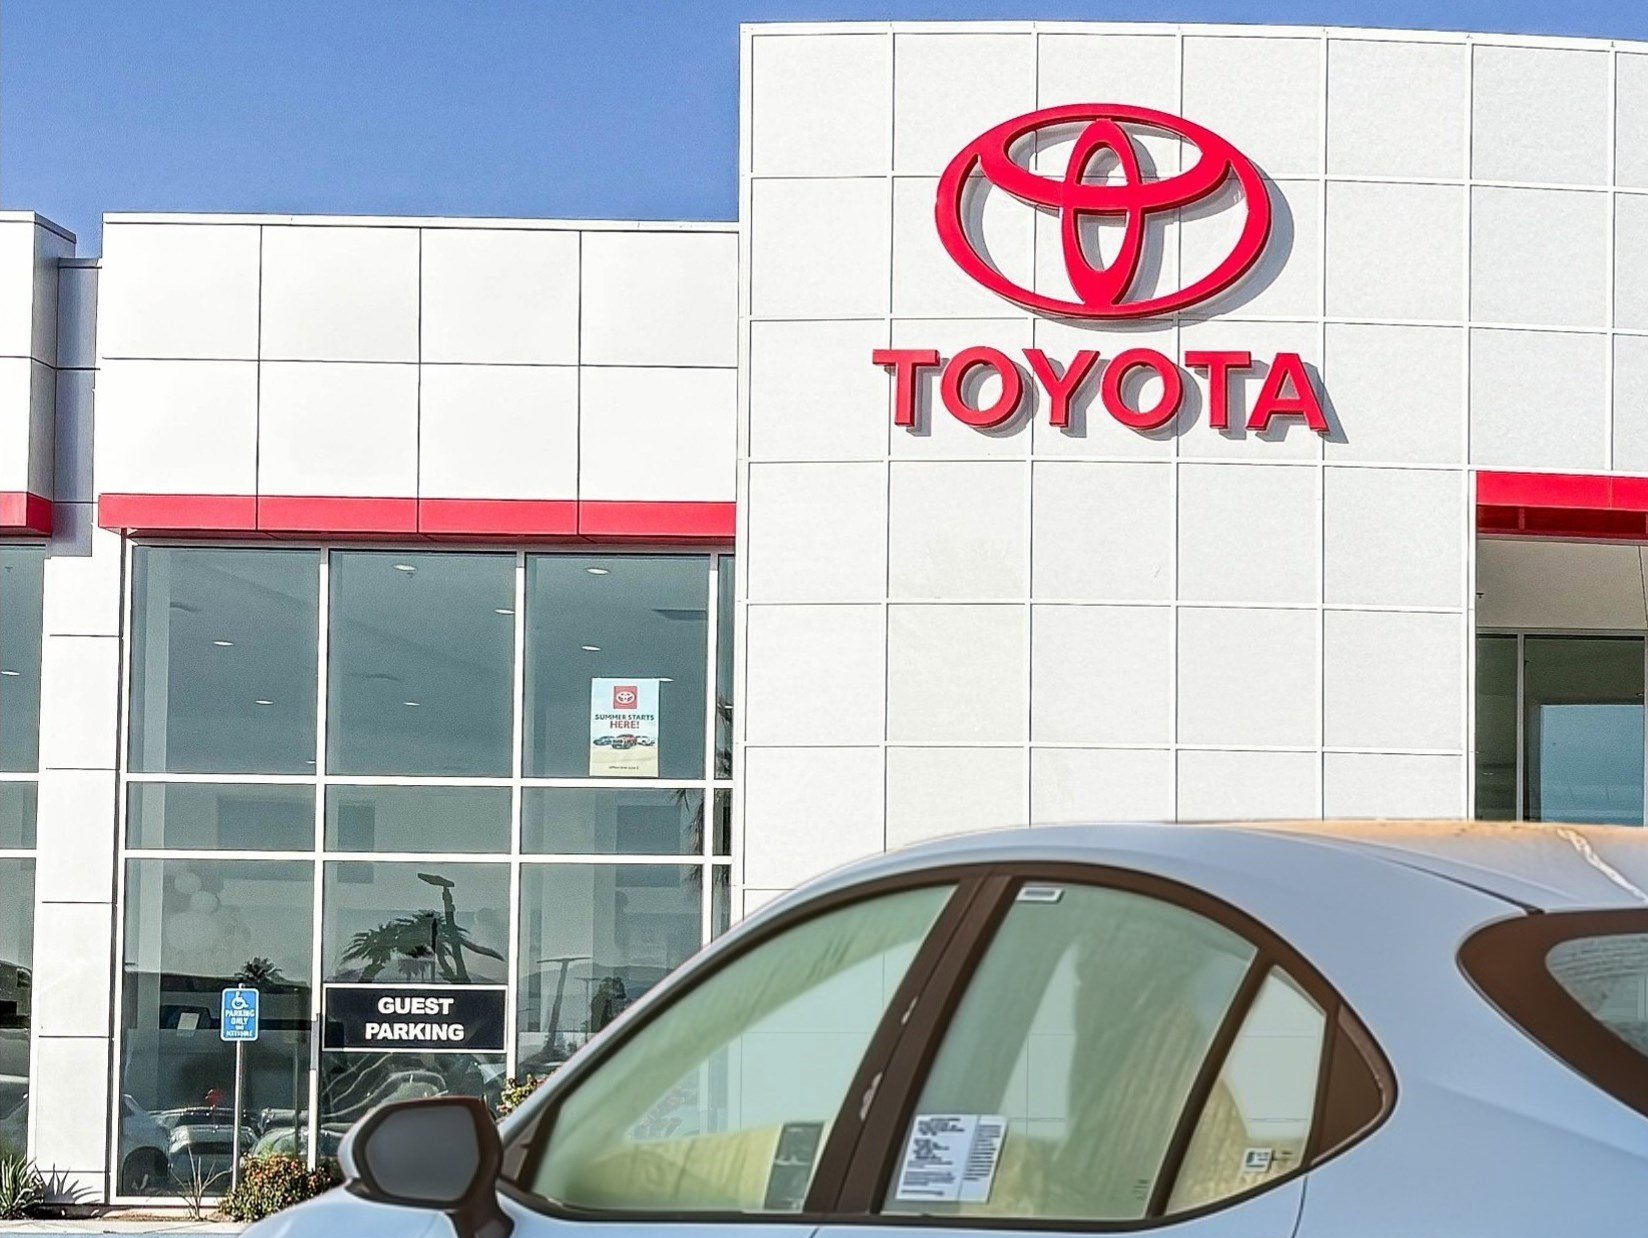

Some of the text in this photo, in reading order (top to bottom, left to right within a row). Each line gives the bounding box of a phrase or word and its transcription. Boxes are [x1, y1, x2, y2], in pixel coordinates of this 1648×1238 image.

[872, 346, 1329, 432] TOYOTA
[610, 721, 640, 729] HERE!
[377, 997, 454, 1015] GUEST
[365, 1022, 465, 1041] PARKING
